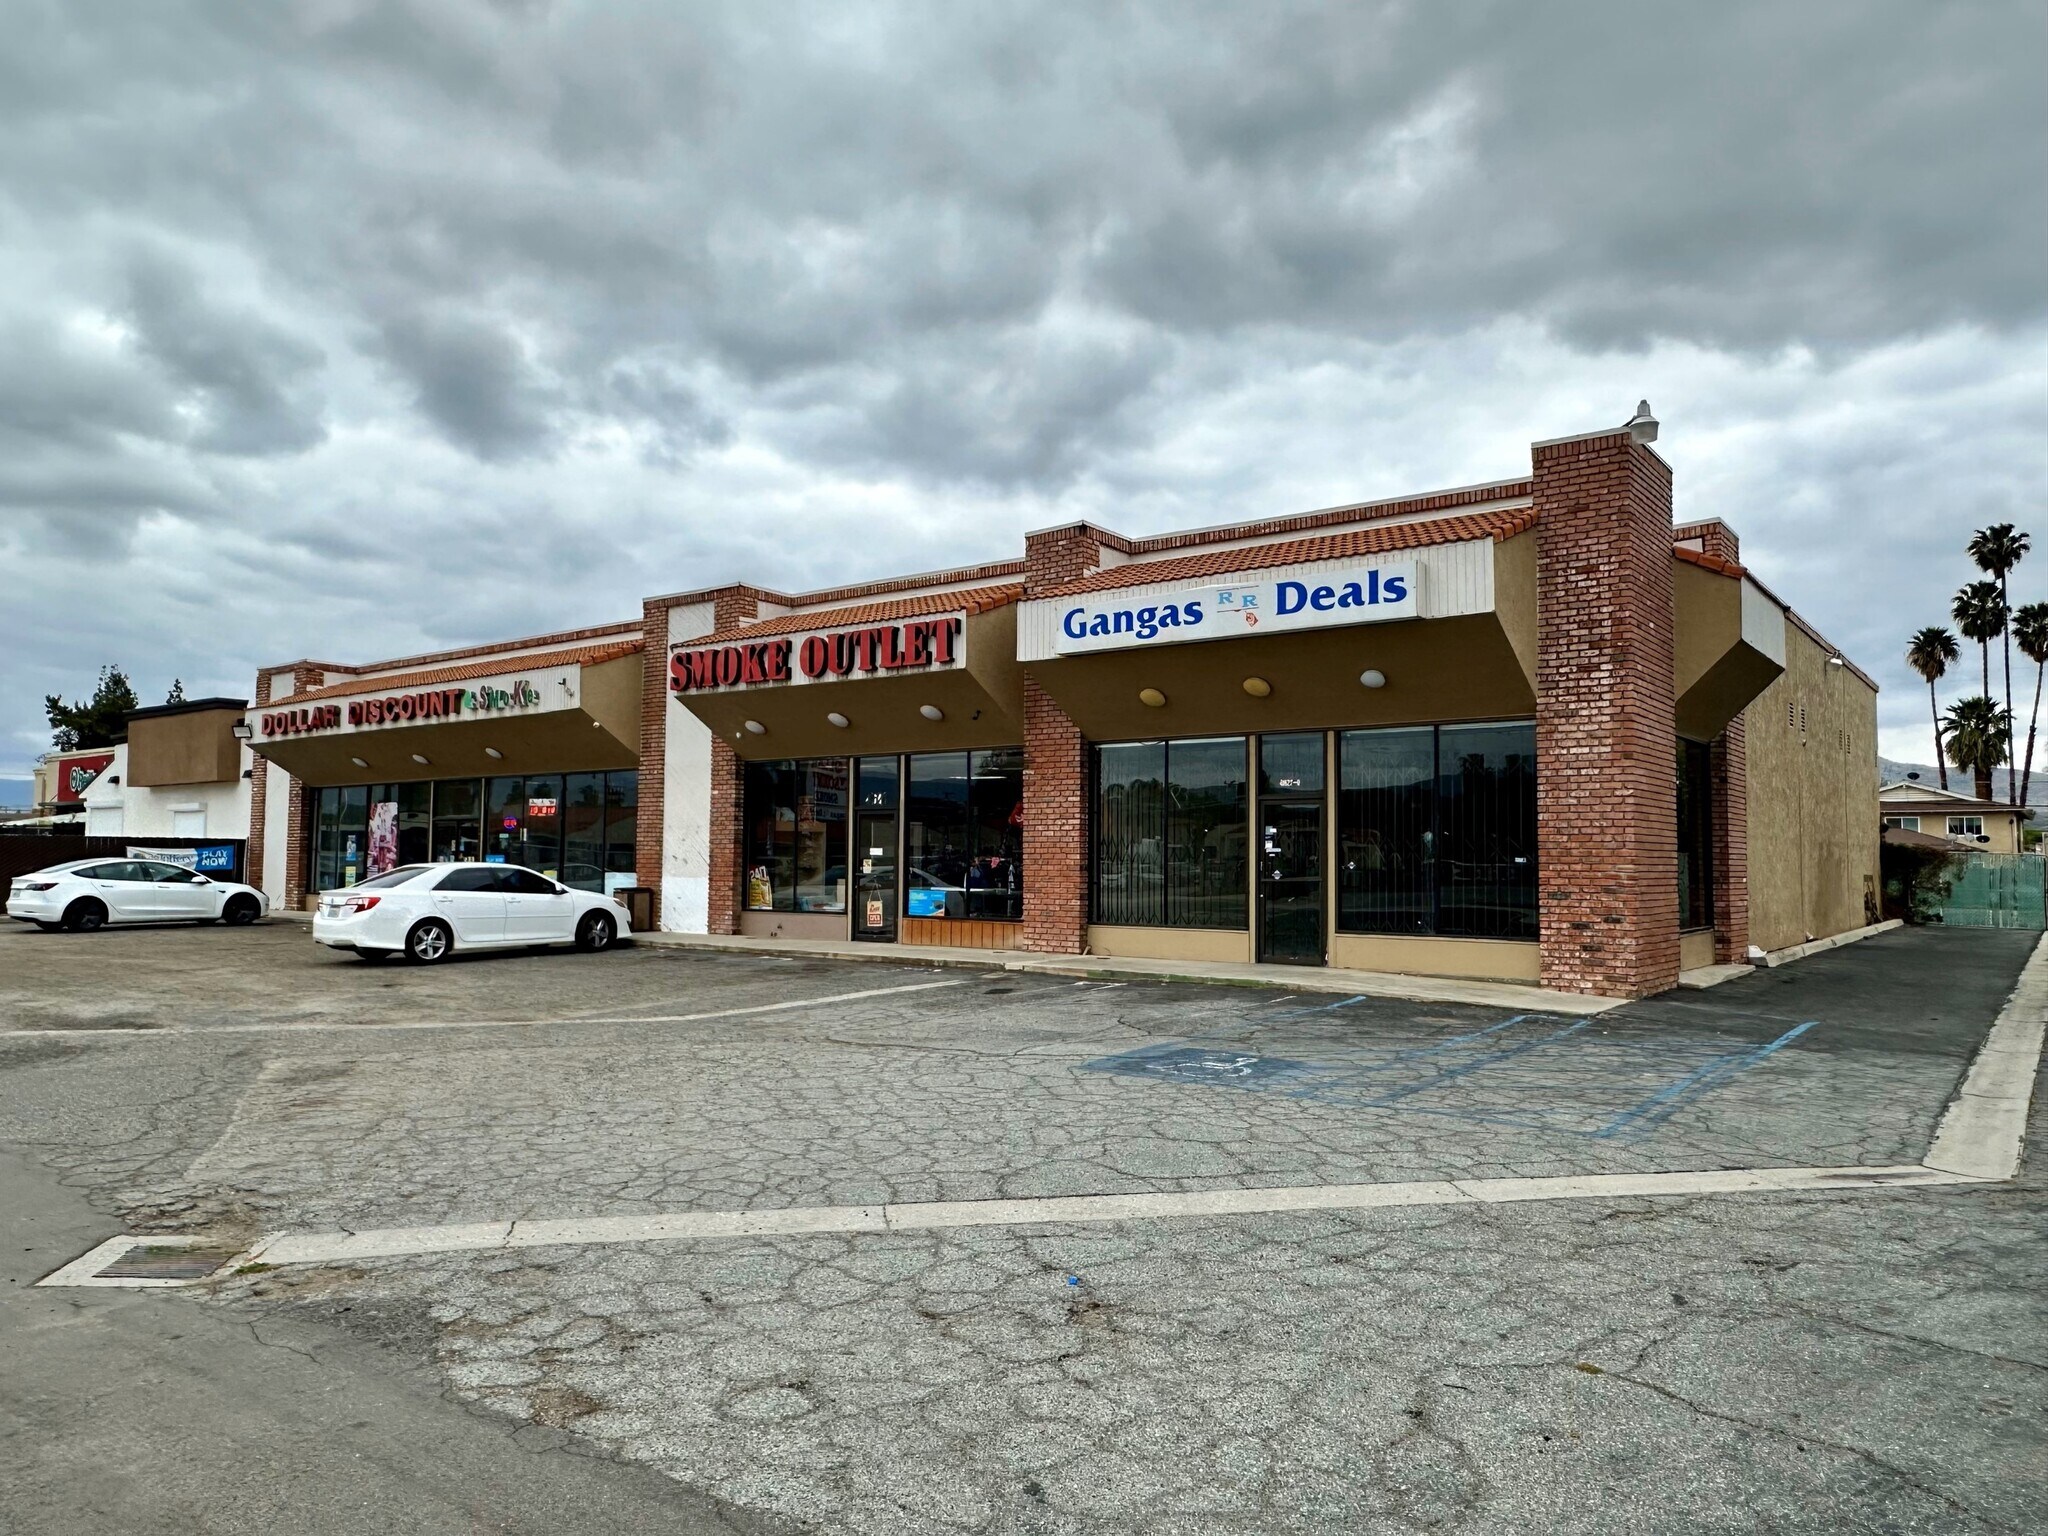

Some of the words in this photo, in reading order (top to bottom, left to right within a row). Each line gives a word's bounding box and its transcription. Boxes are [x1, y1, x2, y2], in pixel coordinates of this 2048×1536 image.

[1063, 601, 1203, 640] Gangas
[1275, 569, 1408, 616] Deals
[670, 639, 792, 691] SMOKE
[799, 617, 961, 678] OUTLET
[261, 704, 341, 736] DOLLAR
[347, 688, 466, 725] DISCOUNT
[201, 849, 228, 859] PLAY
[201, 857, 228, 866] NOW
